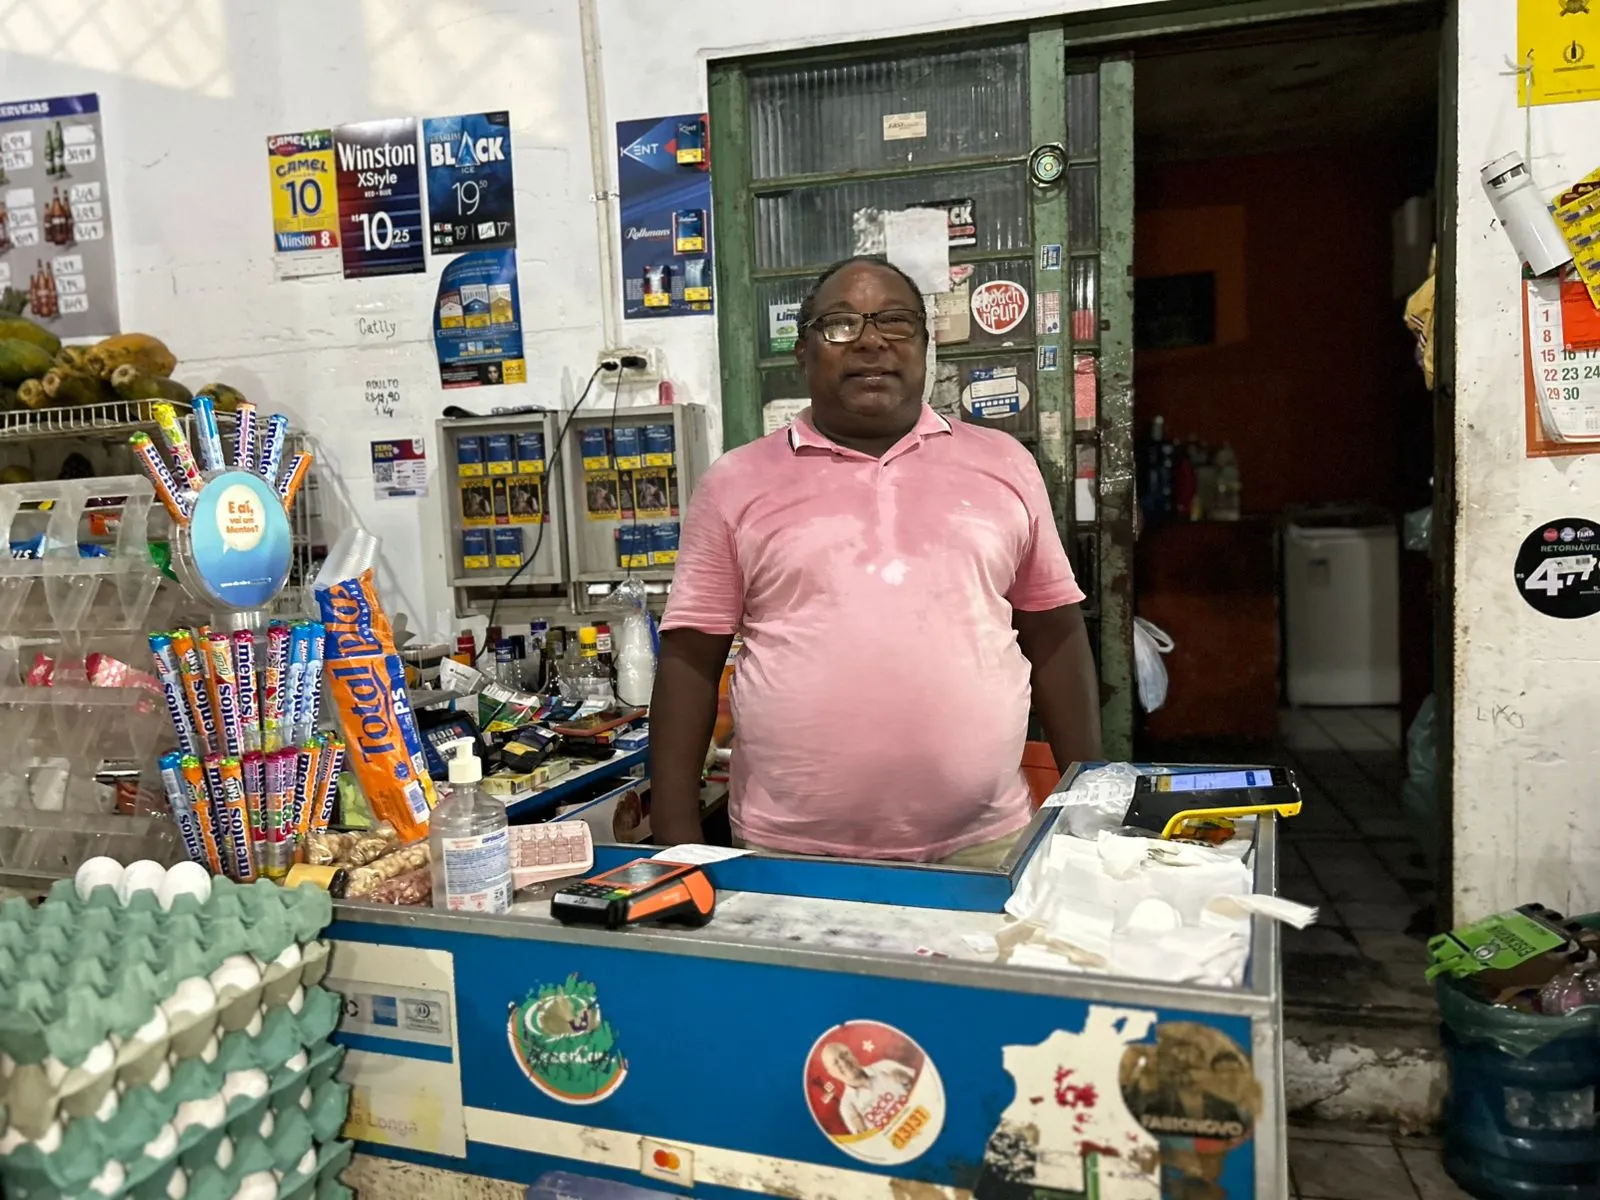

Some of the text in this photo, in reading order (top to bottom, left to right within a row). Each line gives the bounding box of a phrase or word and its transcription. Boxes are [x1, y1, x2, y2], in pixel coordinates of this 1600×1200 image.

[268, 134, 320, 150] CAMEL 14
[430, 131, 505, 167] BLACK
[620, 139, 659, 161] KENT
[336, 142, 416, 172] Winston
[276, 158, 328, 177] CAMEL
[461, 166, 476, 174] ICE
[358, 168, 398, 189] XStyle
[284, 178, 321, 218] 10
[280, 230, 331, 249] Winston 8
[1542, 309, 1550, 322] 1
[1543, 329, 1552, 343] 8
[1540, 350, 1556, 362] 15
[1544, 365, 1600, 381] 22 23 24
[1547, 386, 1580, 400] 29 30
[228, 501, 235, 514] E
[237, 644, 254, 717] mentos
[333, 664, 396, 763] Total
[321, 750, 344, 821] mentos
[231, 807, 250, 877] mentos
